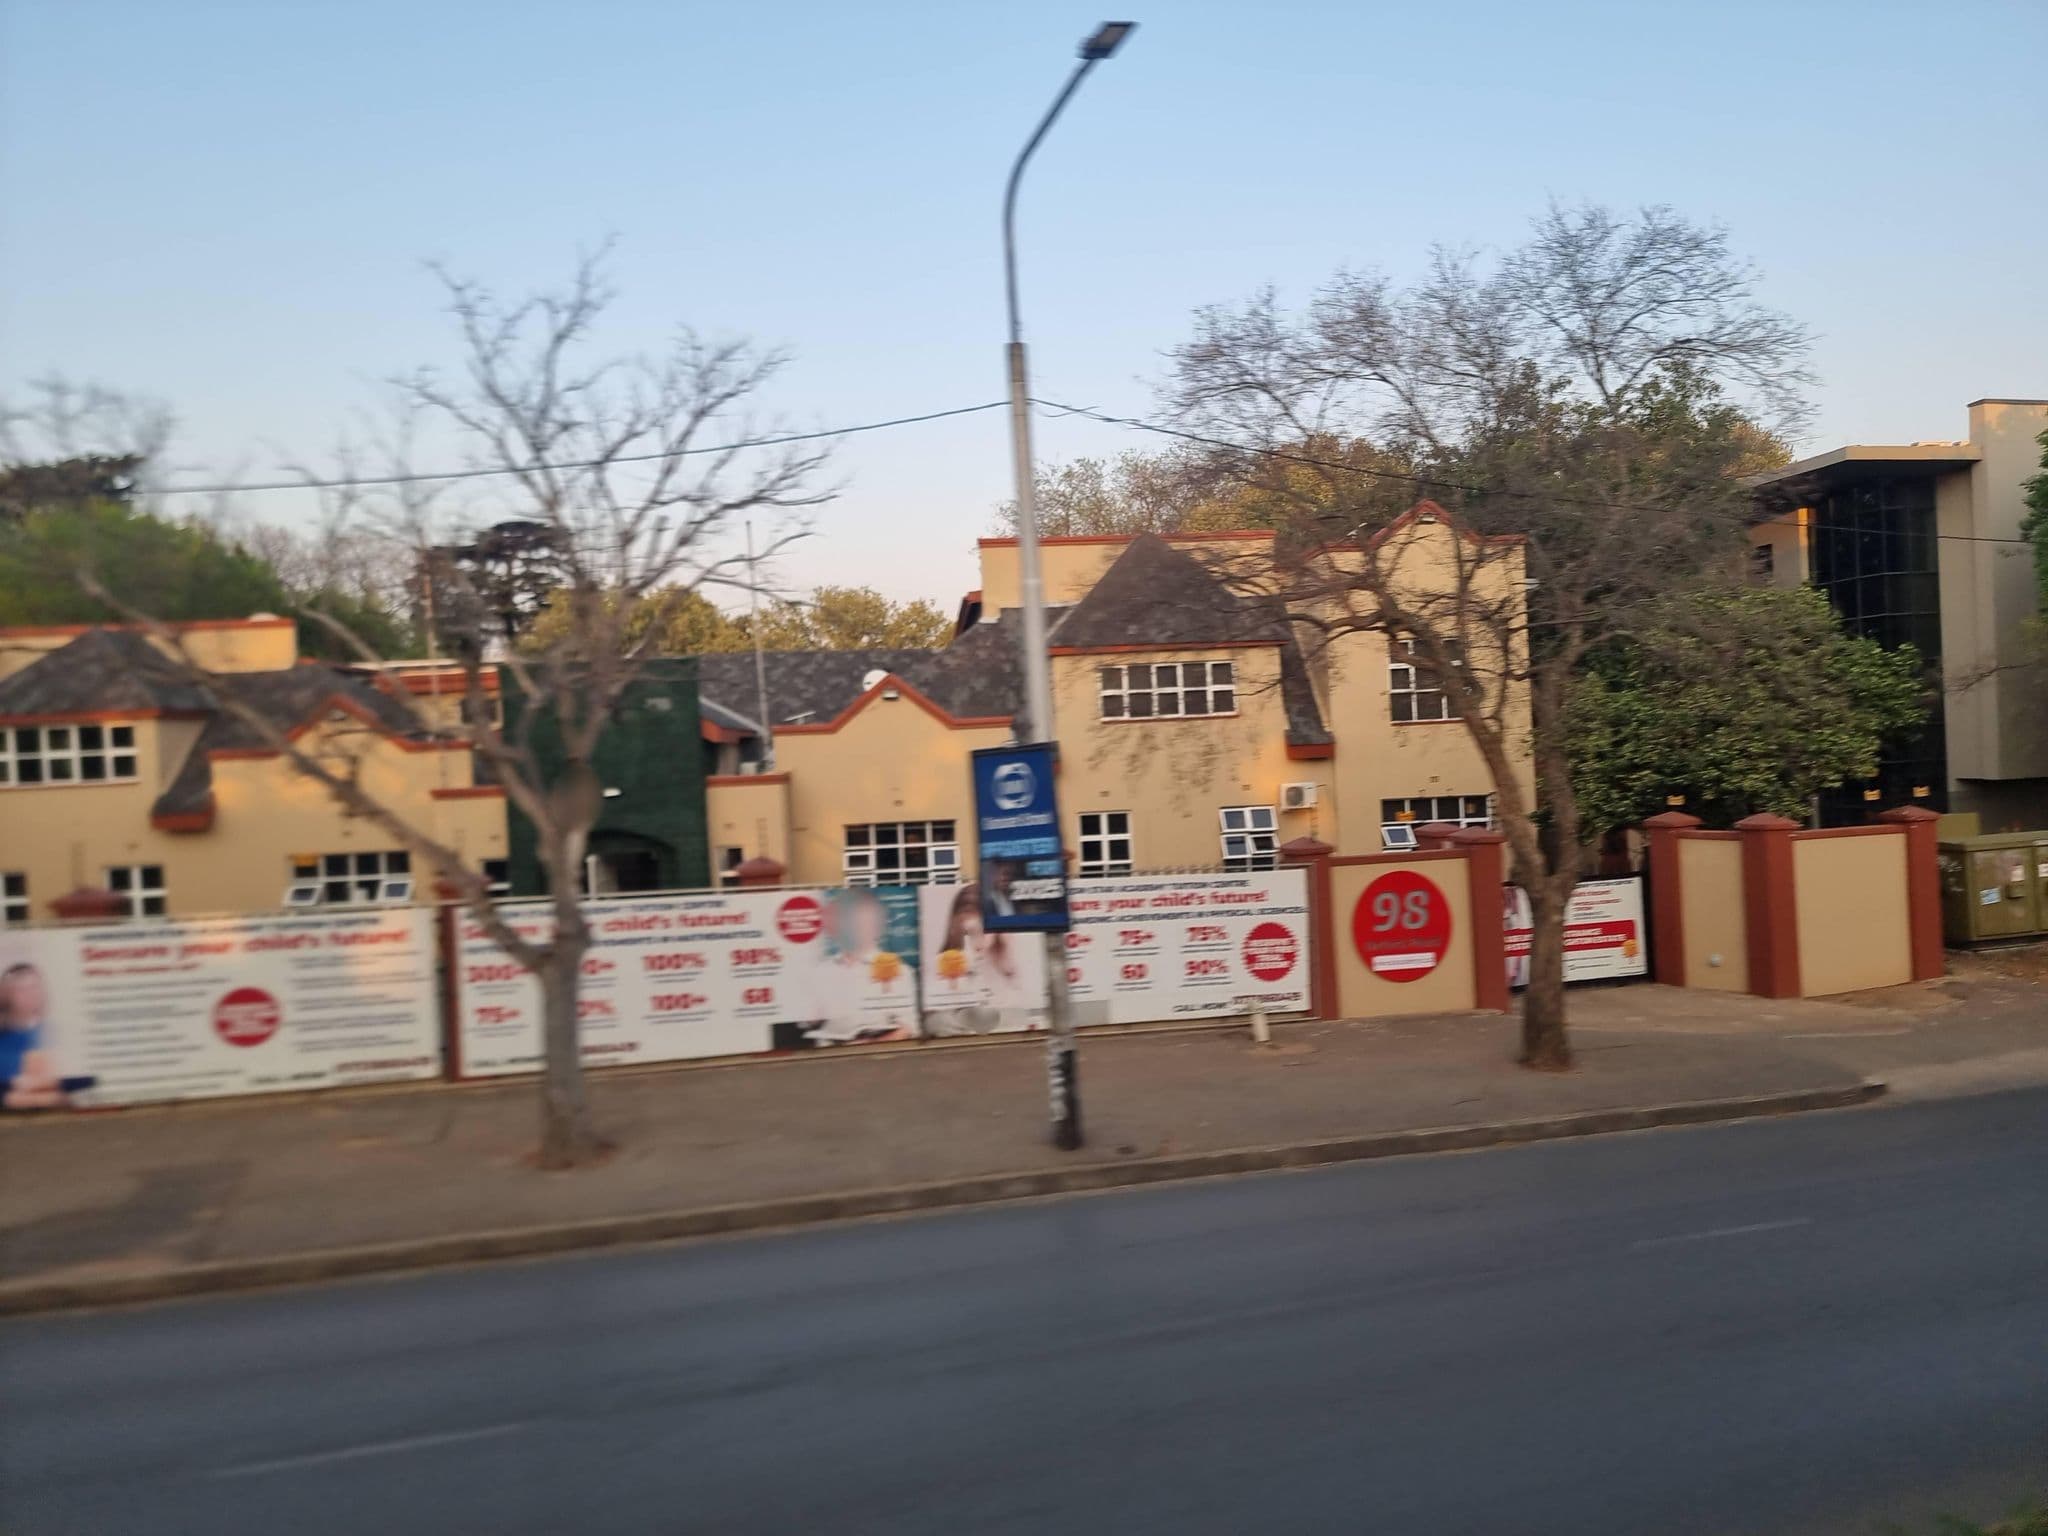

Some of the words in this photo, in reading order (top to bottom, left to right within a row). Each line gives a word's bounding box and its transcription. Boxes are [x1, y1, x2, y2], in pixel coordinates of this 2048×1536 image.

[1107, 898, 1145, 913] your
[1152, 892, 1206, 908] child's
[1211, 890, 1269, 905] future!
[1373, 890, 1429, 932] 98
[603, 914, 672, 932] child's
[1186, 926, 1229, 942] 75%
[641, 952, 708, 971] 100%
[1185, 959, 1230, 976] 90%
[1121, 963, 1148, 980] 60
